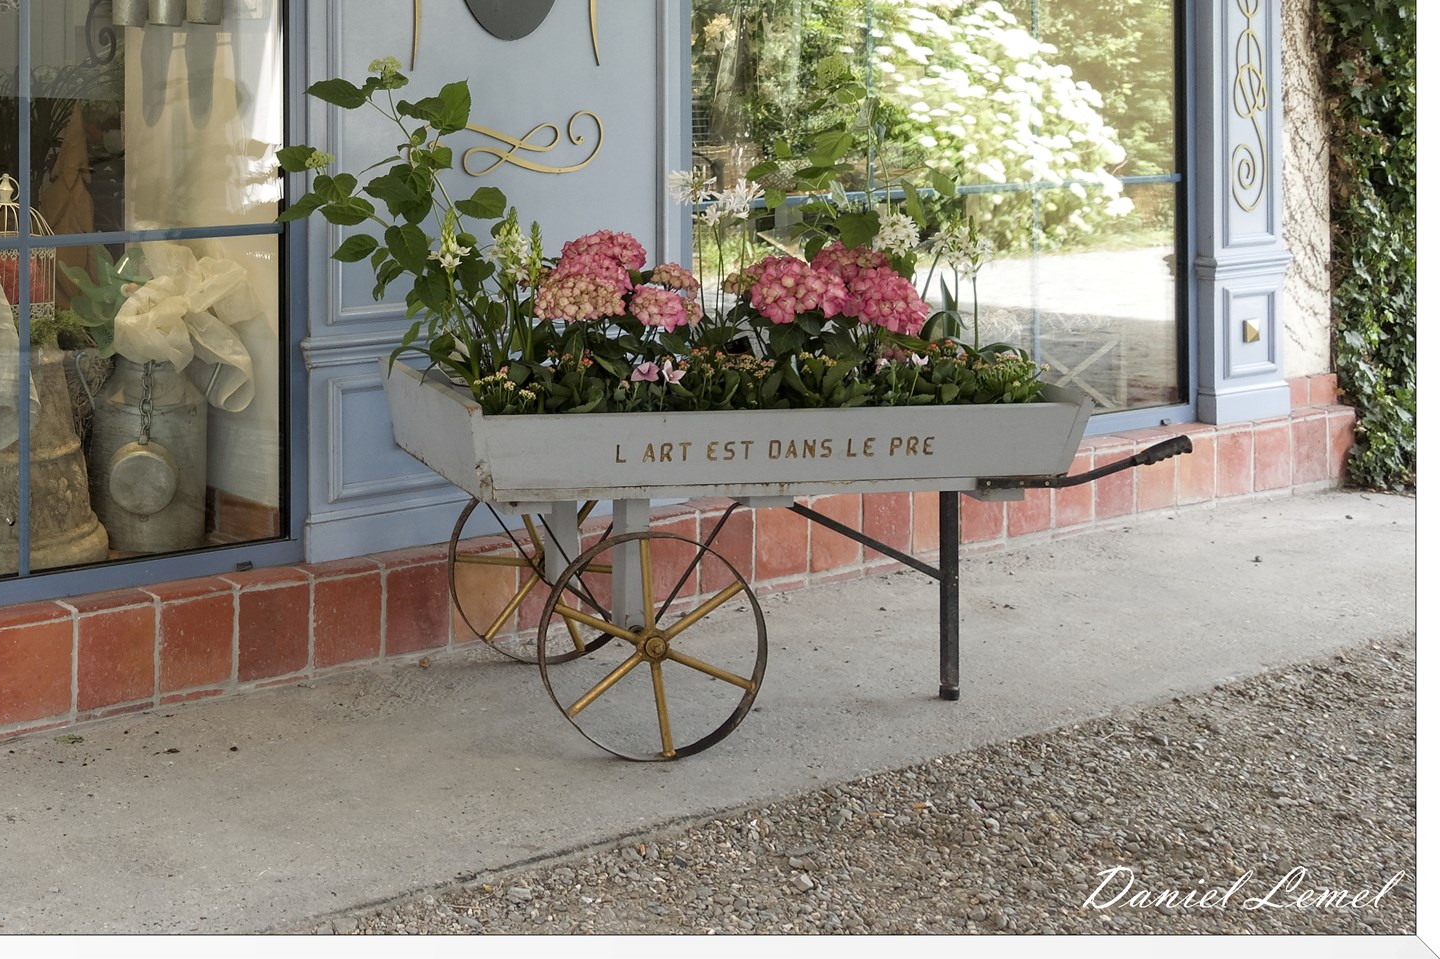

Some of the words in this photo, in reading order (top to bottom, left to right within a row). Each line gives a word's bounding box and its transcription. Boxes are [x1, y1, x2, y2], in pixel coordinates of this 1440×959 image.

[615, 443, 627, 463] L
[642, 441, 692, 462] ART
[706, 439, 755, 461] EST
[768, 438, 833, 460] DANS
[845, 437, 876, 458] LE
[889, 435, 936, 457] PRE
